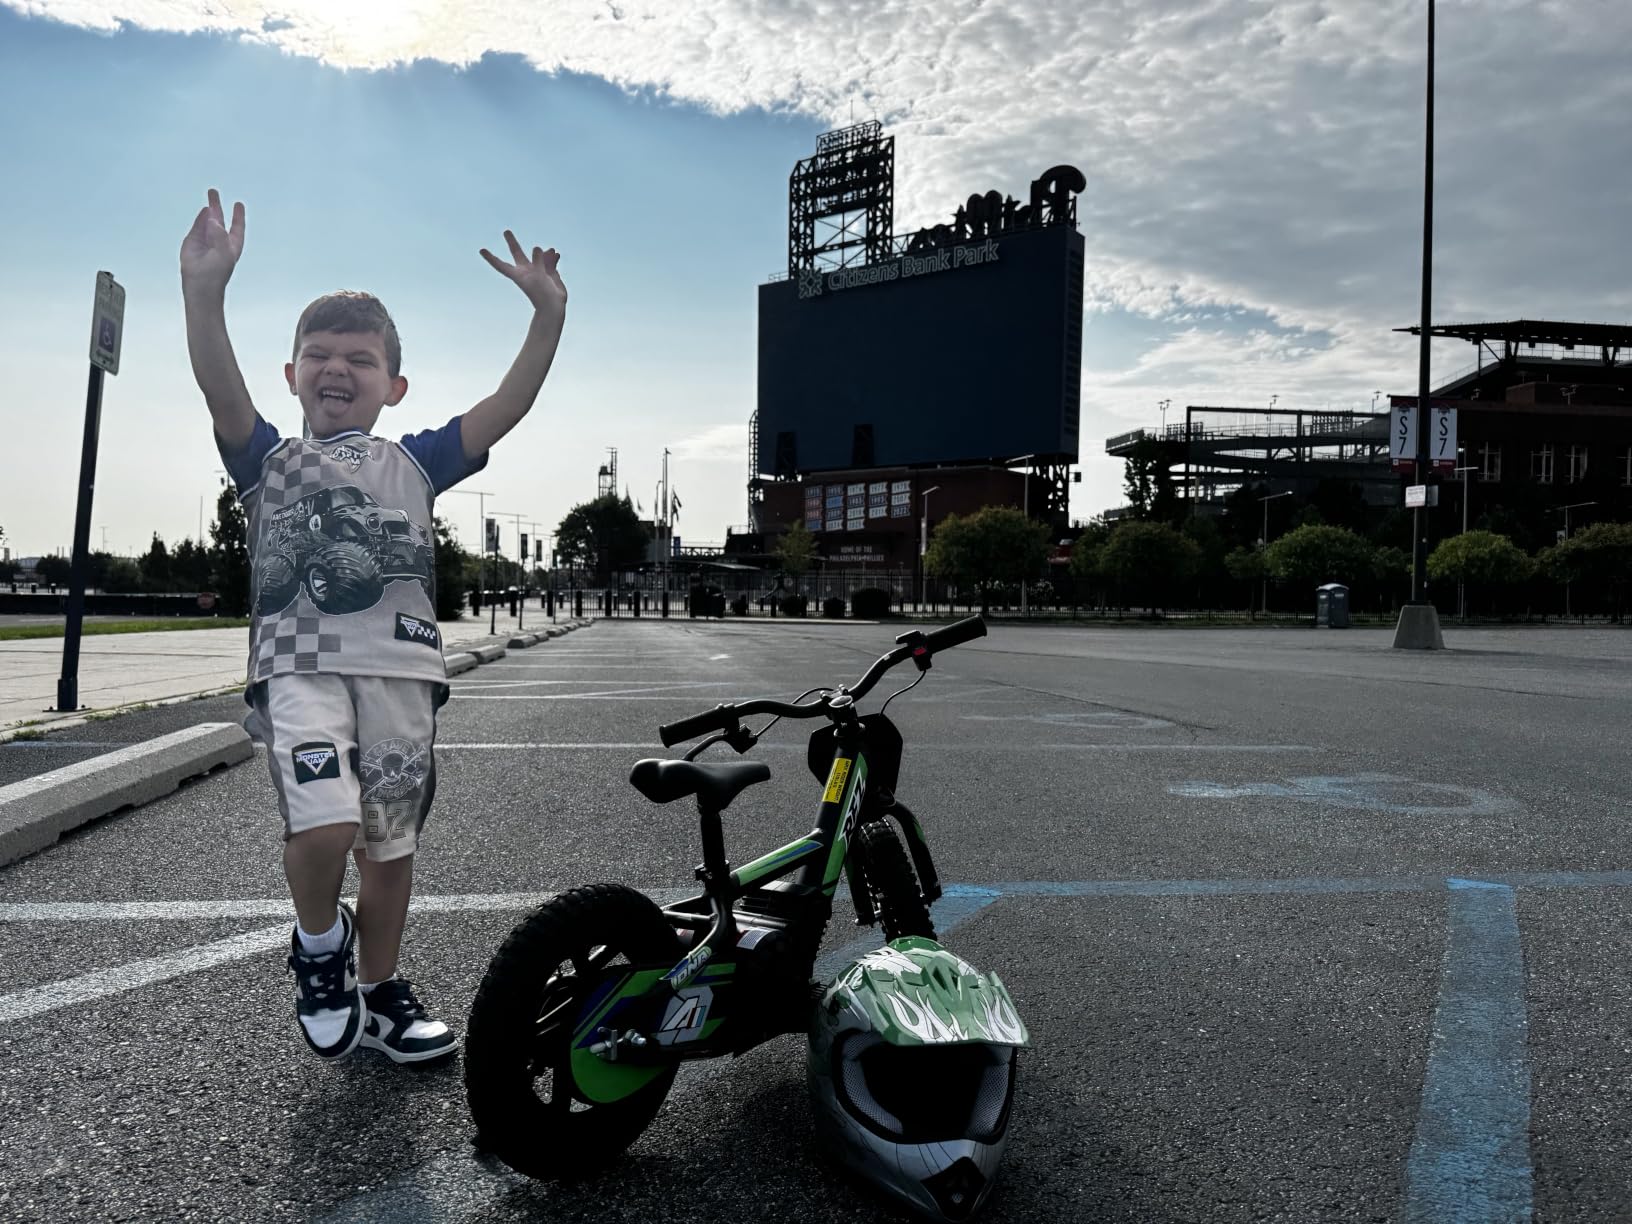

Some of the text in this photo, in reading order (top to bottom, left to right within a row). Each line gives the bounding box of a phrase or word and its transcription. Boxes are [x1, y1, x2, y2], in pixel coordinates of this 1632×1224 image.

[827, 238, 999, 291] Citizens Bank Park
[1400, 416, 1408, 436] S
[1440, 416, 1448, 436] S
[1398, 436, 1407, 455] 7
[1439, 438, 1447, 456] 7
